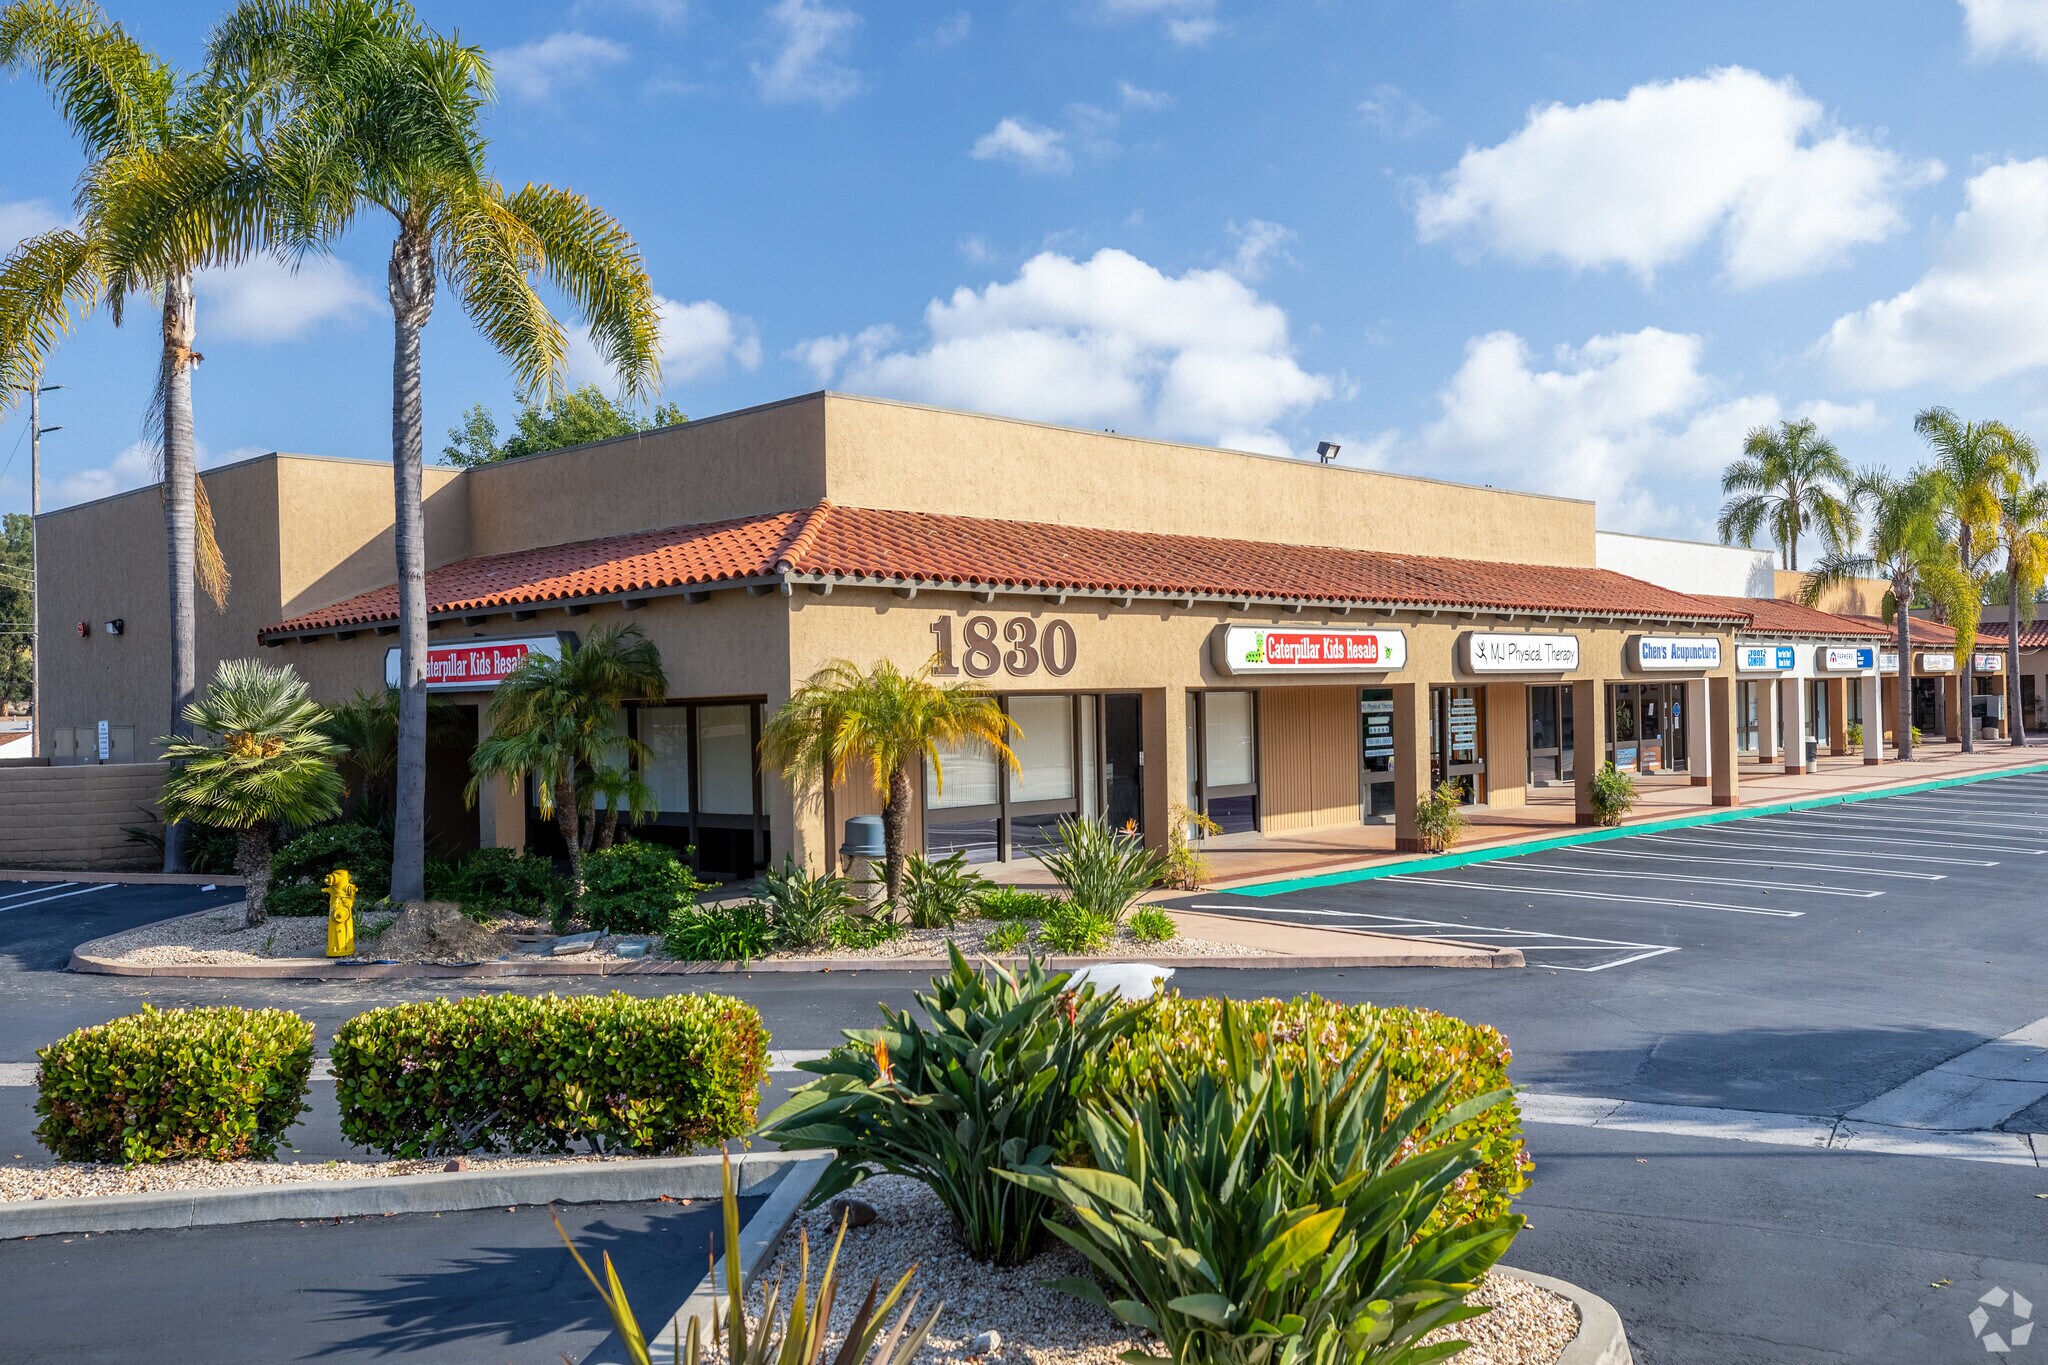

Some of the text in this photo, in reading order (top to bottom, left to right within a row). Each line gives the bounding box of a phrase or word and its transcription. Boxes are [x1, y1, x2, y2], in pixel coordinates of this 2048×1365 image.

[930, 614, 1078, 678] 1830
[1267, 636, 1377, 665] Caterpillar Kids Resale
[1490, 642, 1575, 665] MJ Physical Therapy
[1642, 642, 1717, 663] Chen's Acupuncture
[1750, 649, 1764, 657] FOOT
[1836, 652, 1854, 660] FARMERS
[426, 652, 467, 683] aterpillar
[470, 651, 491, 676] Kids
